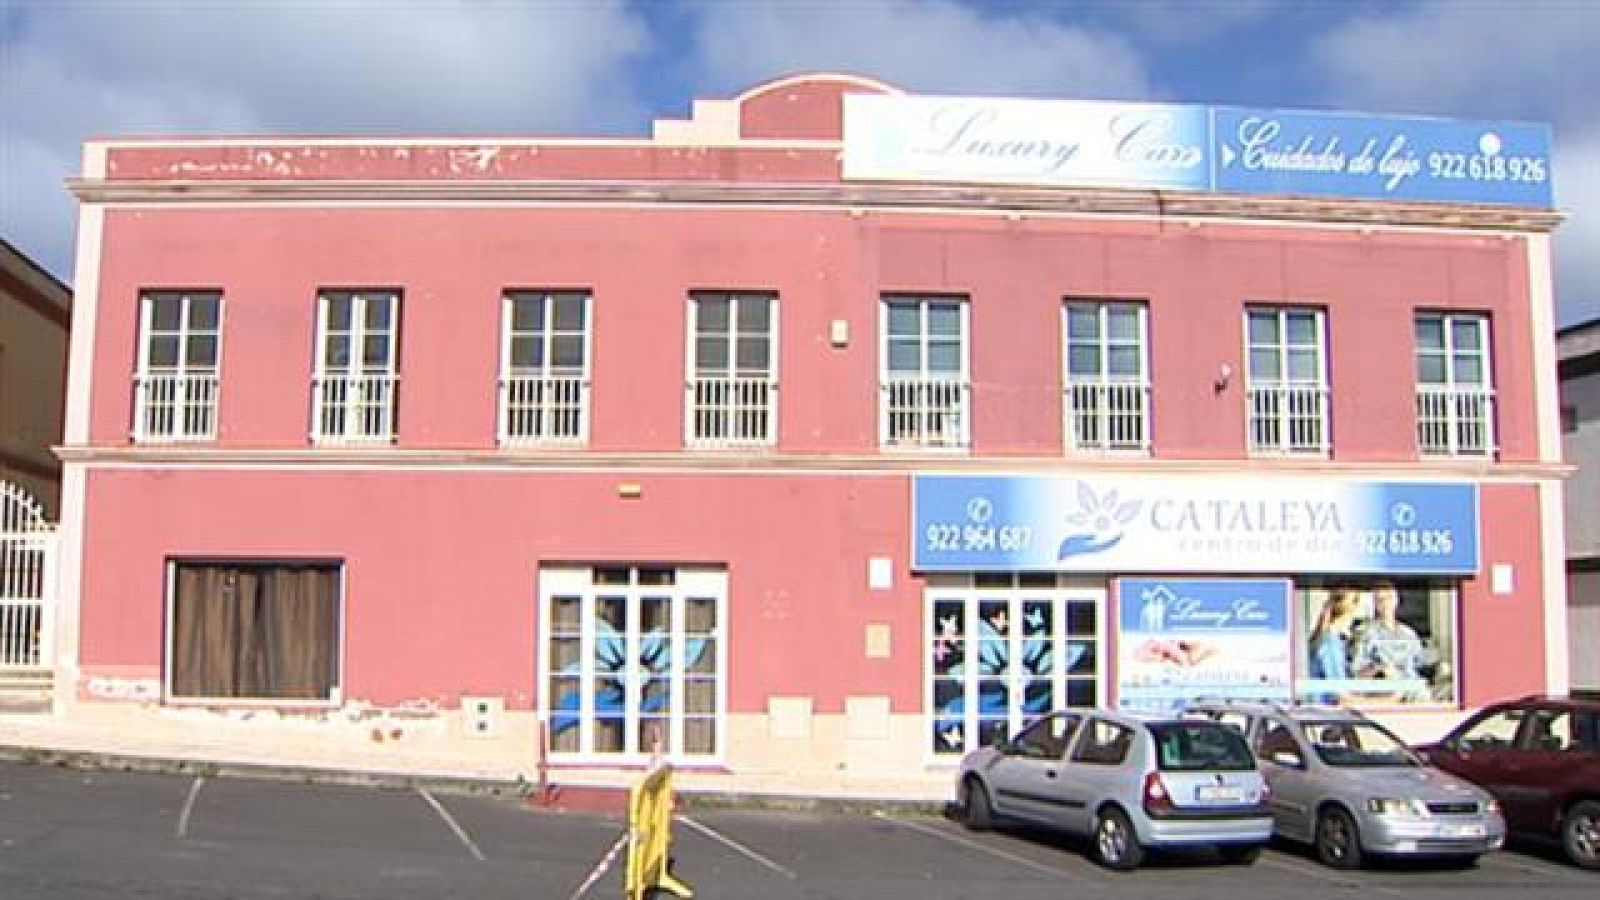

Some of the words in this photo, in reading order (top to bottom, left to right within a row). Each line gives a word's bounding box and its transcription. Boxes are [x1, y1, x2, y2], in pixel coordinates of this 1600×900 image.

[912, 103, 1080, 173] Luxury
[1240, 117, 1346, 170] Cuidados
[1350, 139, 1376, 174] de
[1379, 134, 1421, 191] lujo
[1429, 152, 1465, 178] 922
[1469, 154, 1505, 181] 618
[1509, 156, 1546, 181] 926
[1150, 499, 1345, 532] CATALEYA
[927, 523, 961, 551] 922
[1179, 536, 1261, 553] centro
